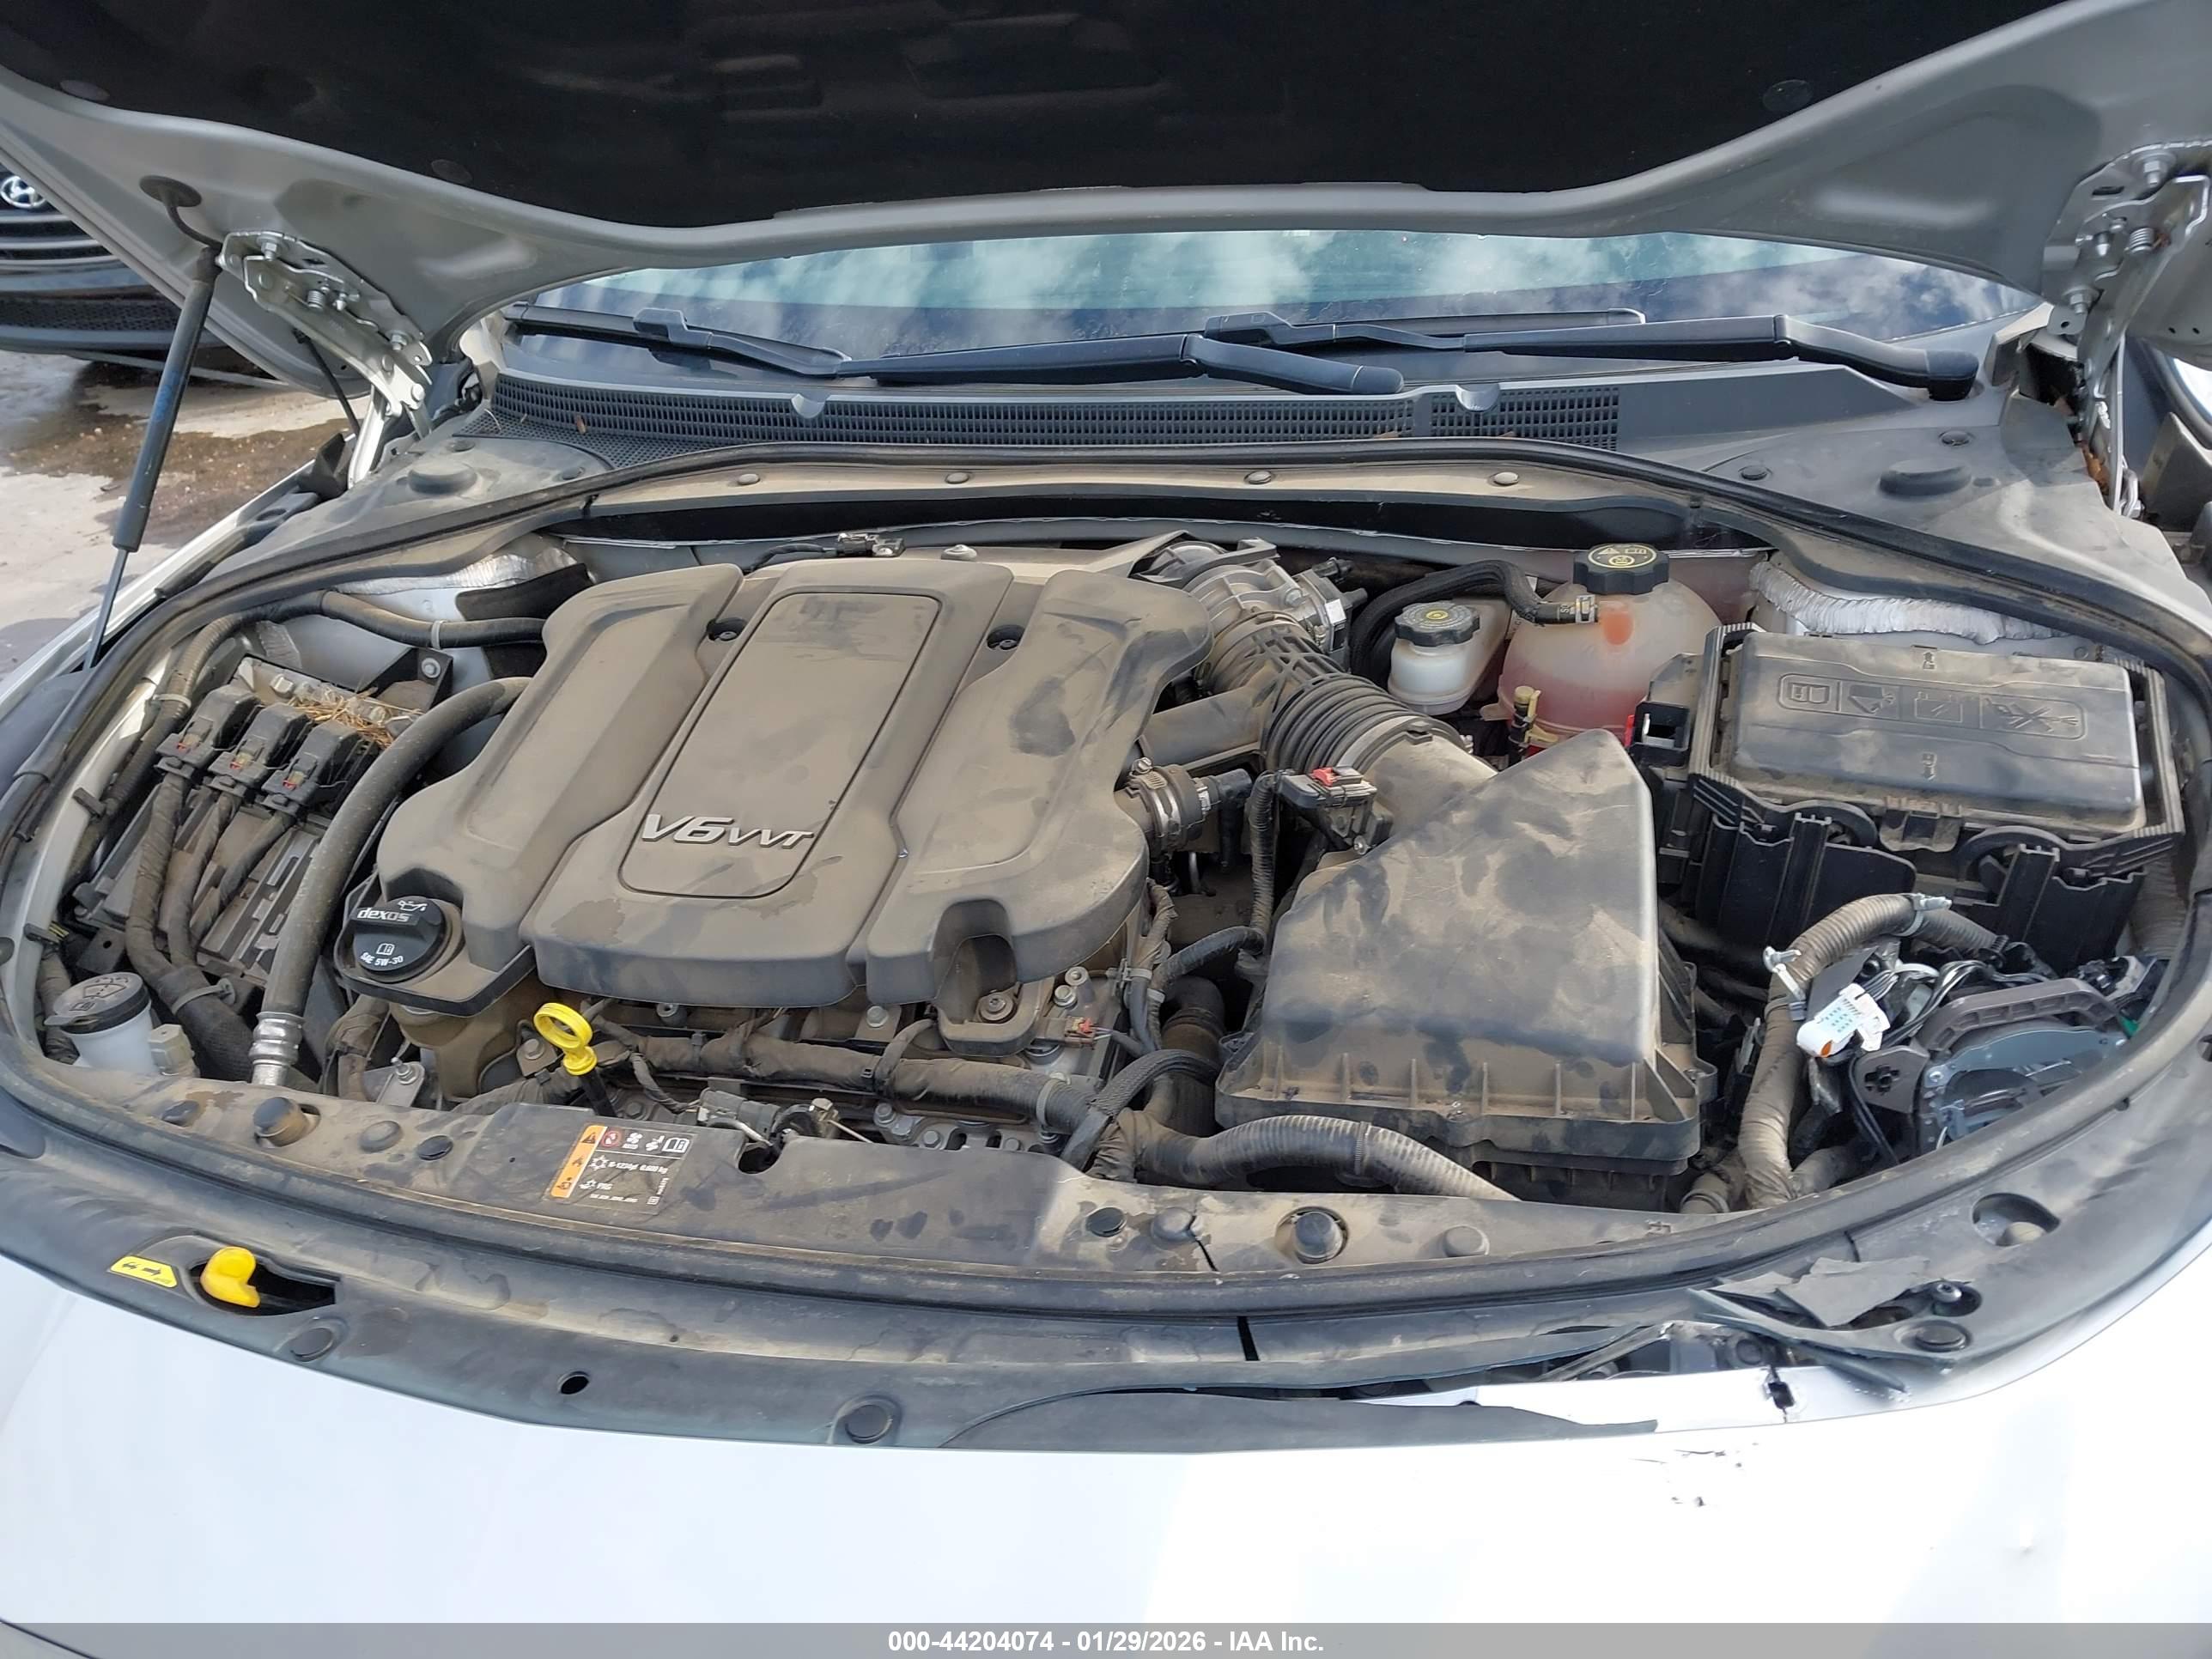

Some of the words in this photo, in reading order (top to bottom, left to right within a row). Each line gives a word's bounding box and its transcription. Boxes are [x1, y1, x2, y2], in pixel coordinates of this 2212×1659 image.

[642, 814, 734, 844] V6
[728, 827, 814, 849] VVT
[357, 908, 412, 922] dexos
[374, 955, 404, 966] 5W-30
